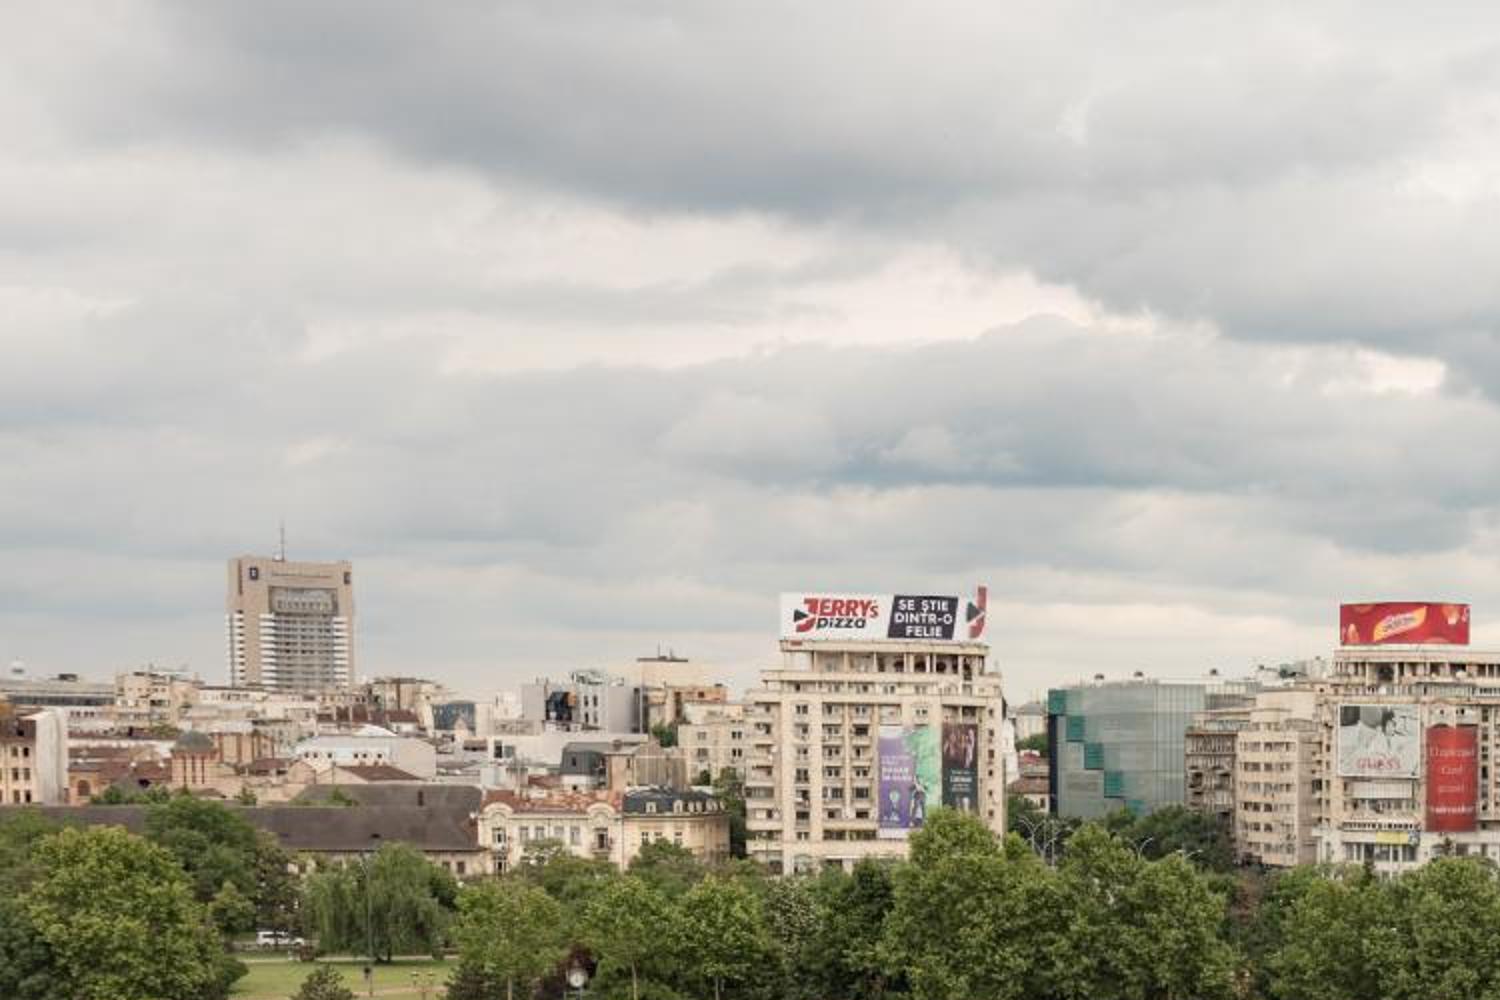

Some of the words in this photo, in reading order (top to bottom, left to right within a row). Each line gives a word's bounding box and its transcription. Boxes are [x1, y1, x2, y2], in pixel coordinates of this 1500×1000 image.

[898, 599, 915, 610] SE
[894, 612, 953, 624] DINTR-O
[905, 626, 943, 637] FELIE
